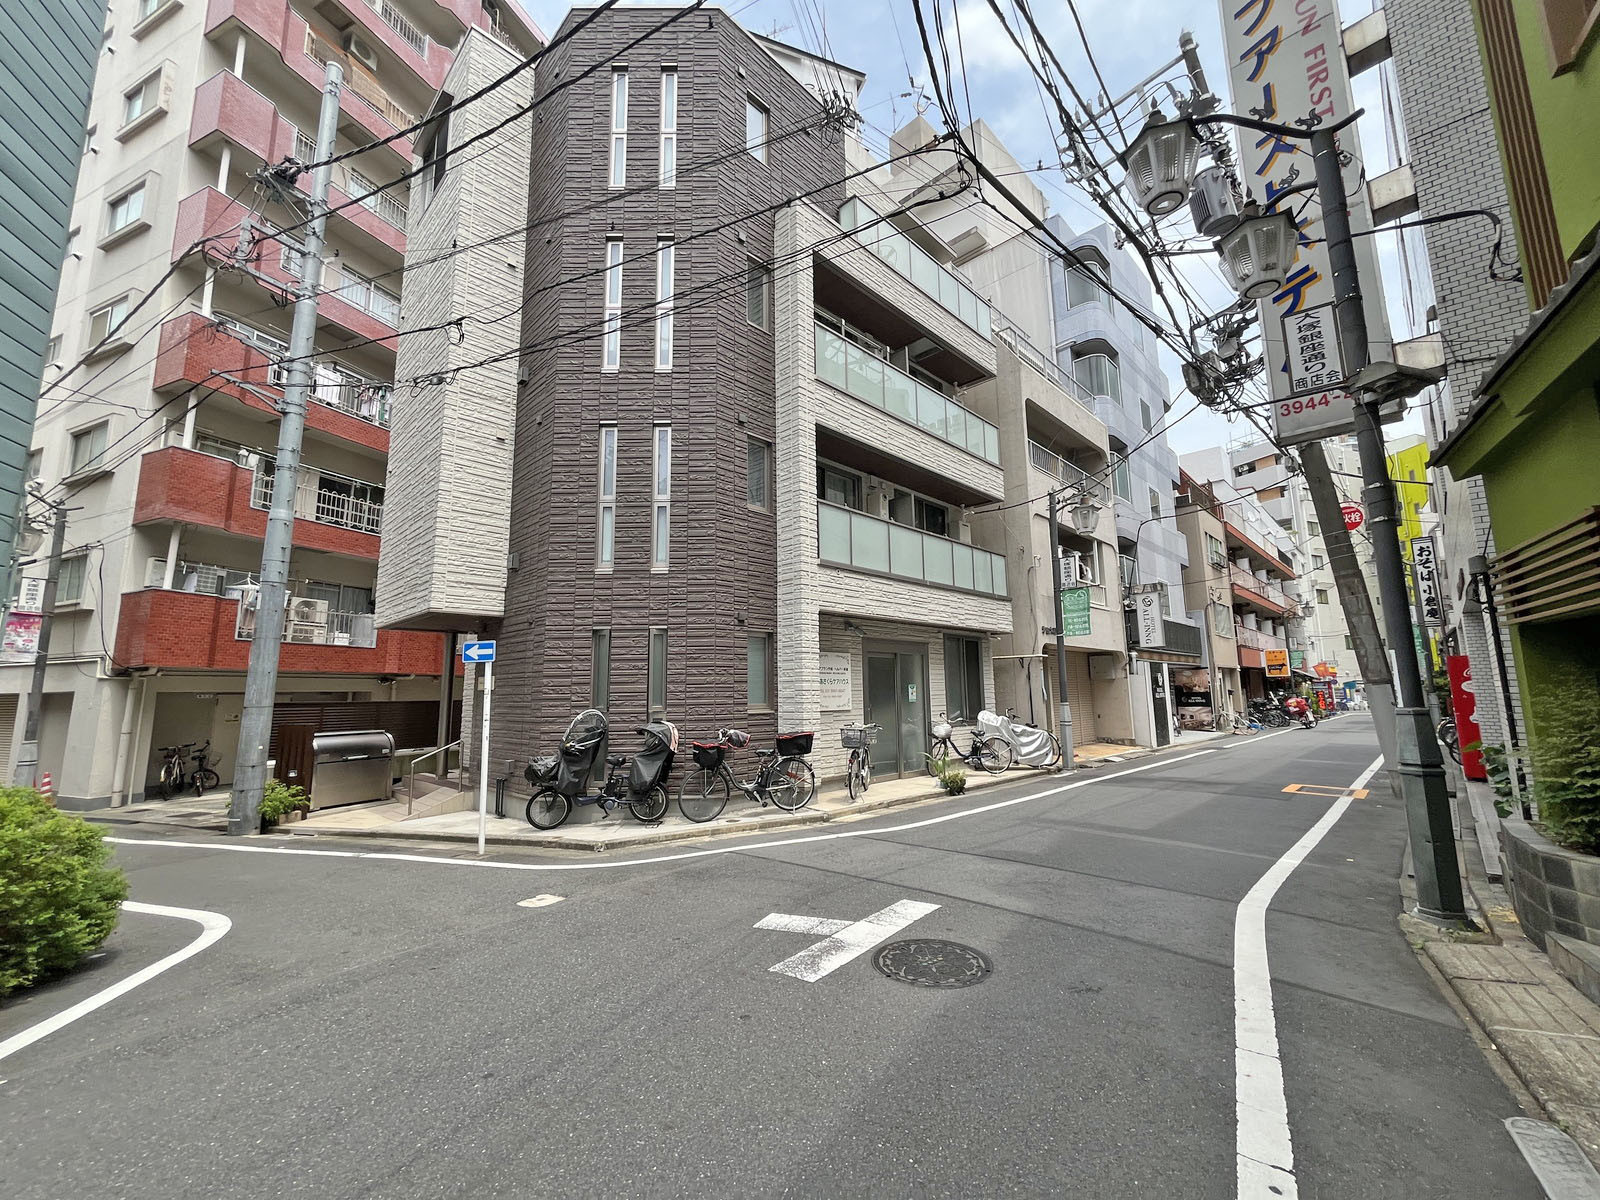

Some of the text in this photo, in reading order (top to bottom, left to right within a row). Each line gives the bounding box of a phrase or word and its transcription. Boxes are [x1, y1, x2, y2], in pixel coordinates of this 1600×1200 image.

[1304, 43, 1335, 119] FIRST
[1294, 310, 1328, 374] 大塚銀座通り
[1294, 369, 1341, 390] 商店会
